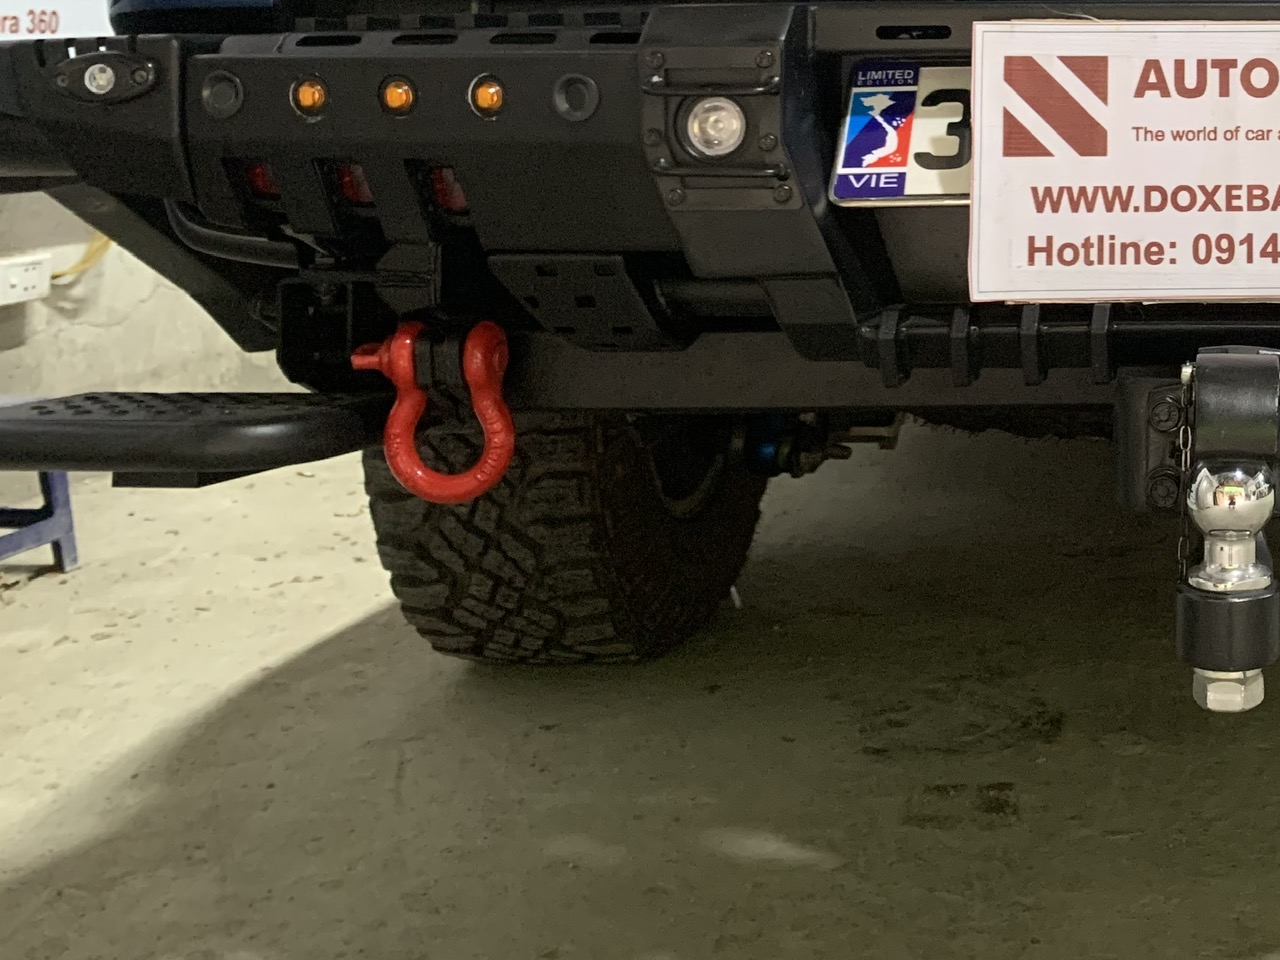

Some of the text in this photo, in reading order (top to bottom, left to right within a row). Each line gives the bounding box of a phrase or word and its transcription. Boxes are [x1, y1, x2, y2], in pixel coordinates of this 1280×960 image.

[26, 9, 59, 34] 360
[857, 69, 914, 81] LIMITED
[1132, 57, 1280, 99] AUTO
[1132, 126, 1165, 142] The
[1171, 126, 1218, 142] world
[1223, 125, 1241, 141] of
[1245, 127, 1273, 141] car
[848, 172, 900, 188] VIE
[1027, 234, 1177, 267] Hotline:
